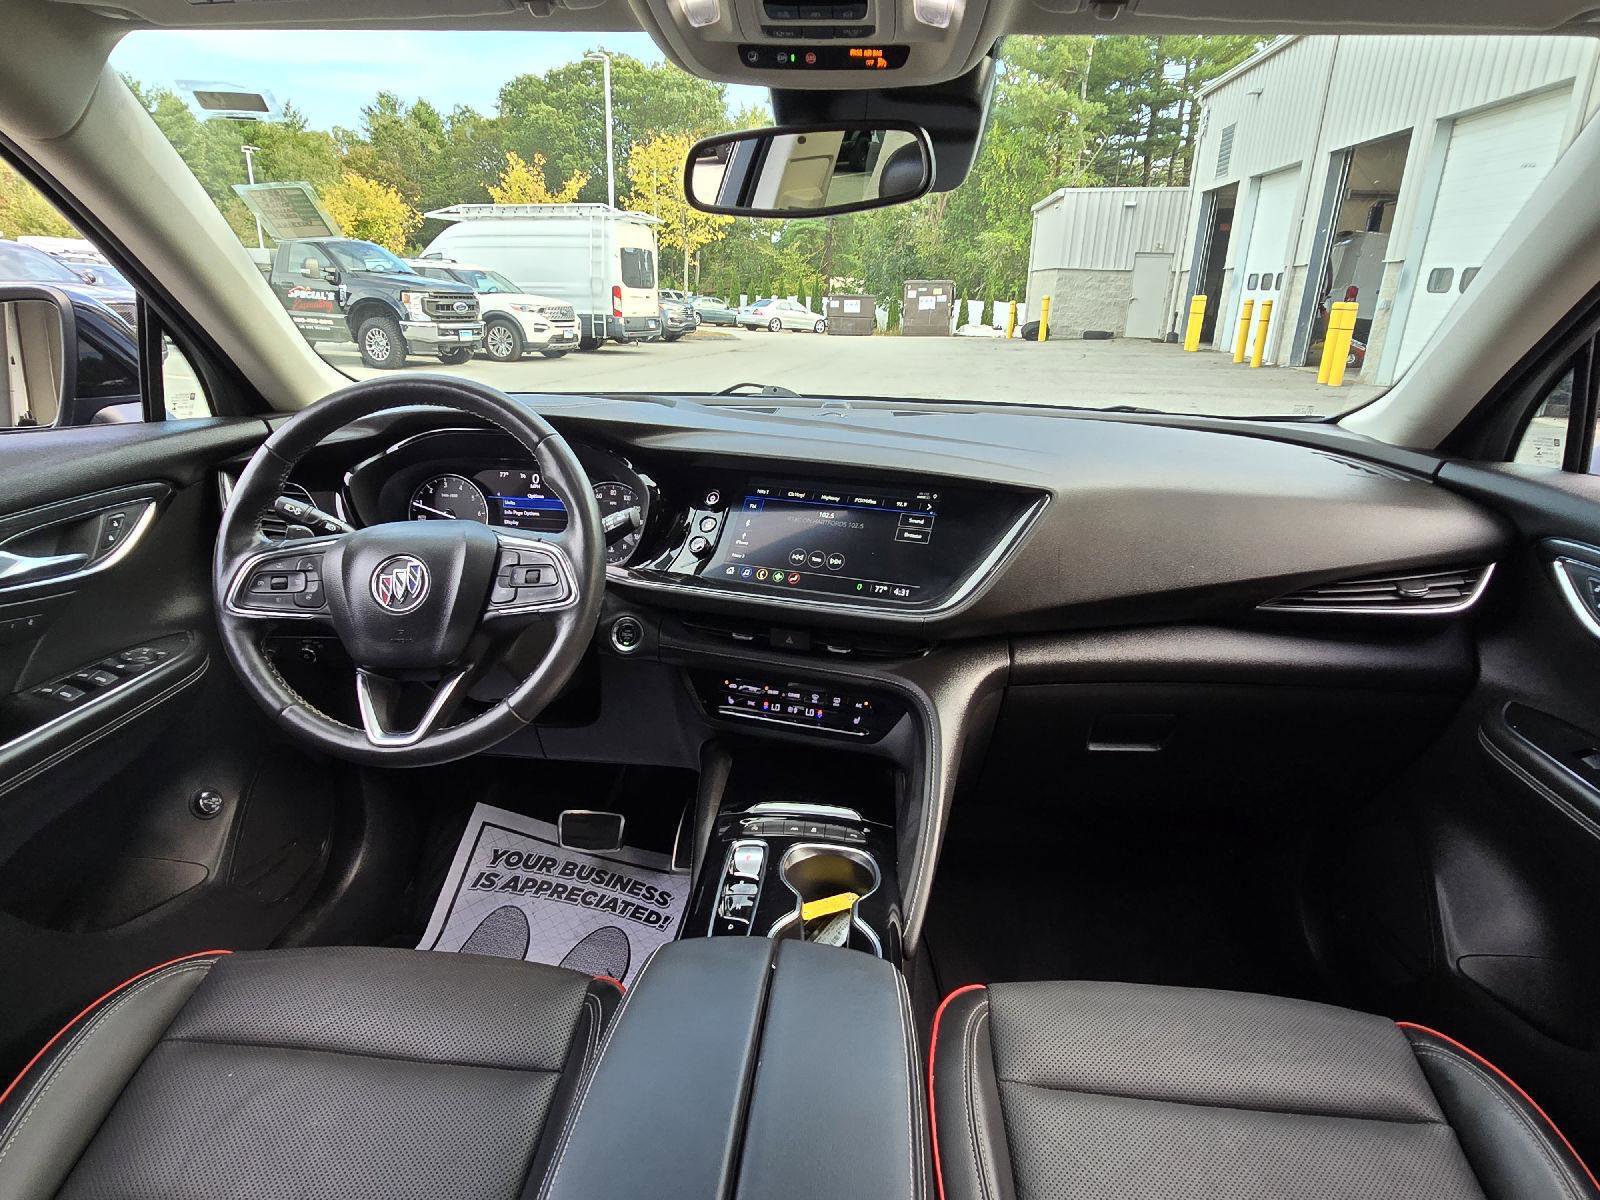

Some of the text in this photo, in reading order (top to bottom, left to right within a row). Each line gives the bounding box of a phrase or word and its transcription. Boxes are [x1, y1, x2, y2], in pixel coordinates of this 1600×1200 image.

[531, 473, 540, 484] 0
[893, 587, 910, 596] 4:31
[487, 849, 675, 908] YOUR BUSINESS
[469, 871, 675, 932] IS APPRECIATED!
